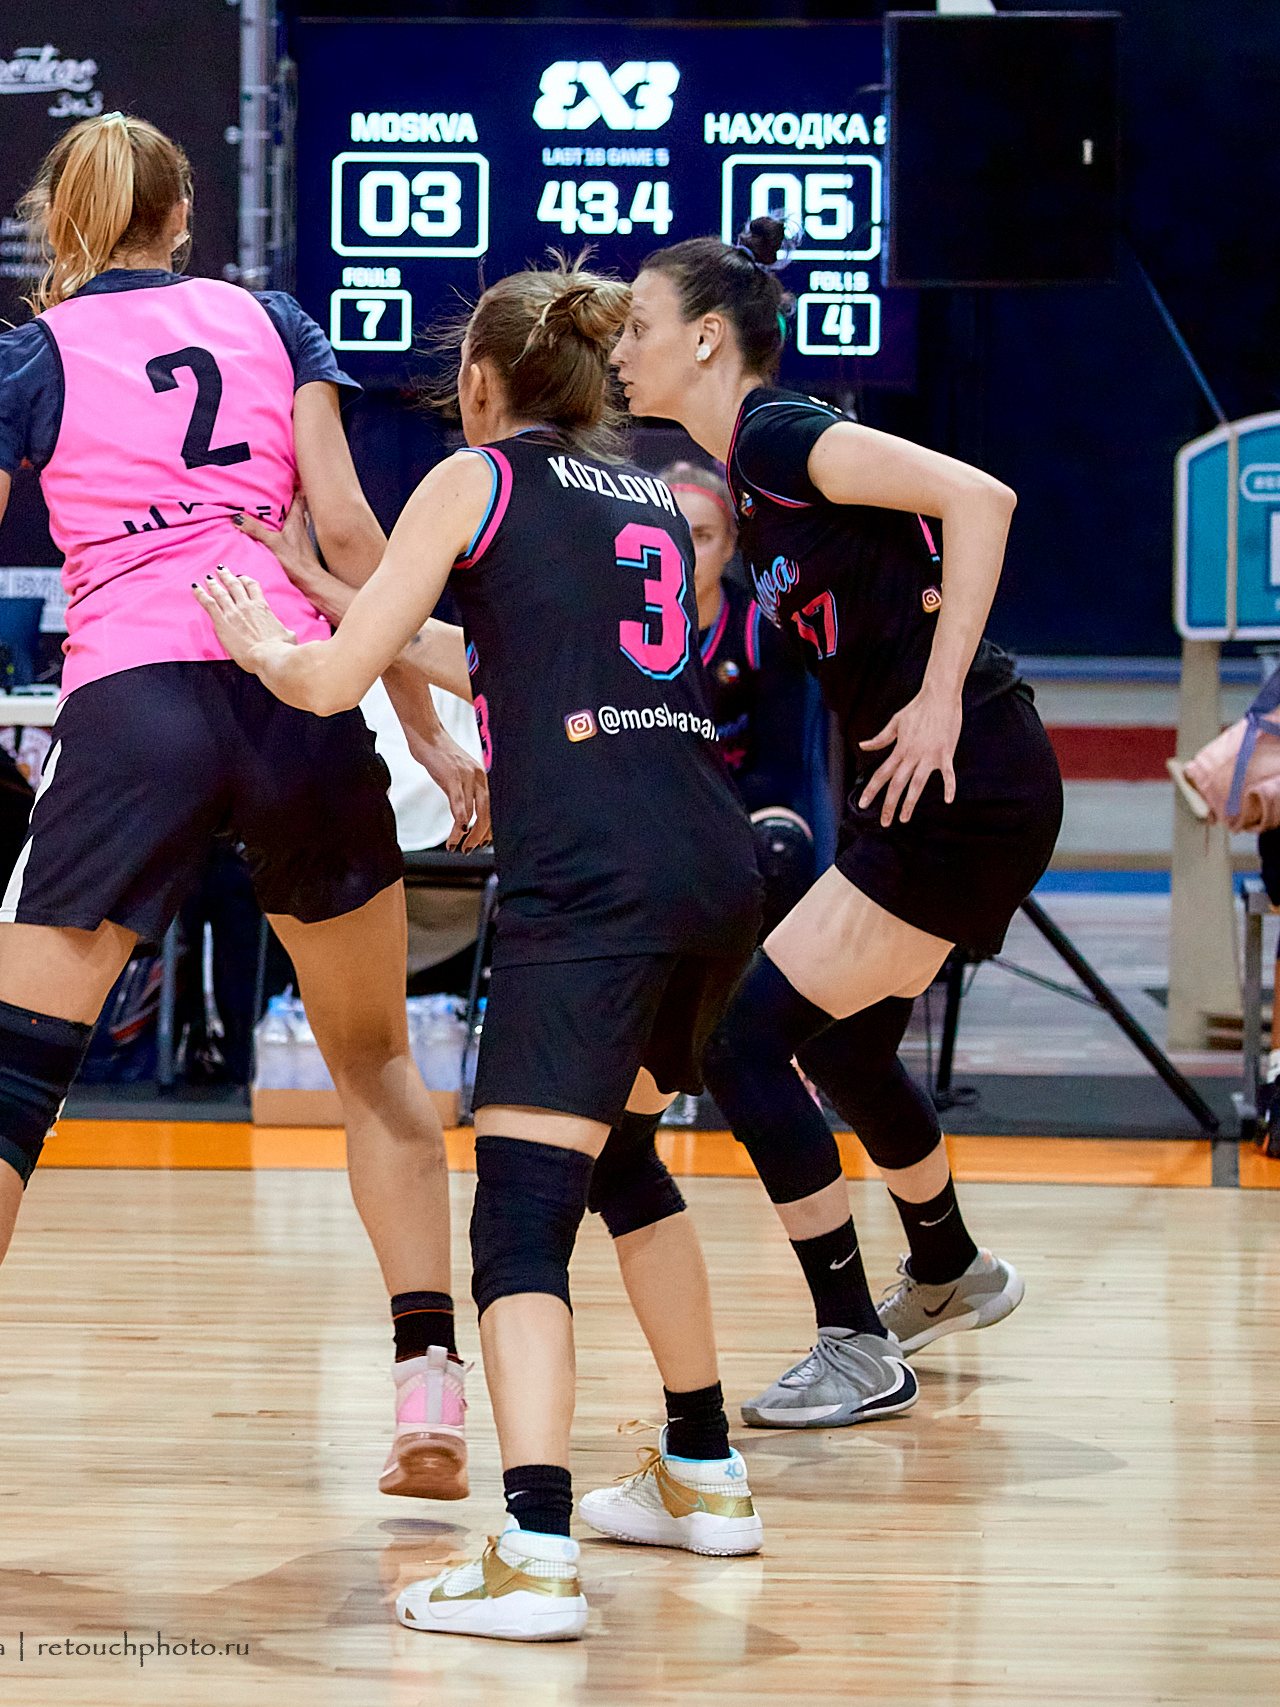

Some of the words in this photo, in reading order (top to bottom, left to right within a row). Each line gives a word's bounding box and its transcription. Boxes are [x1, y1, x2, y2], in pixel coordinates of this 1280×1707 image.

[350, 112, 478, 143] MOSKVA
[704, 112, 870, 150] НАХОДКА
[542, 147, 583, 167] LAST
[606, 147, 655, 167] GAME
[358, 170, 462, 237] 03
[536, 180, 674, 235] 43.4
[751, 172, 854, 240] 05
[342, 266, 402, 288] FOULS
[355, 299, 387, 340] 7
[821, 304, 856, 345] 4
[145, 346, 251, 469] 2
[547, 455, 677, 517] KOZLOVA
[615, 522, 691, 681] 3
